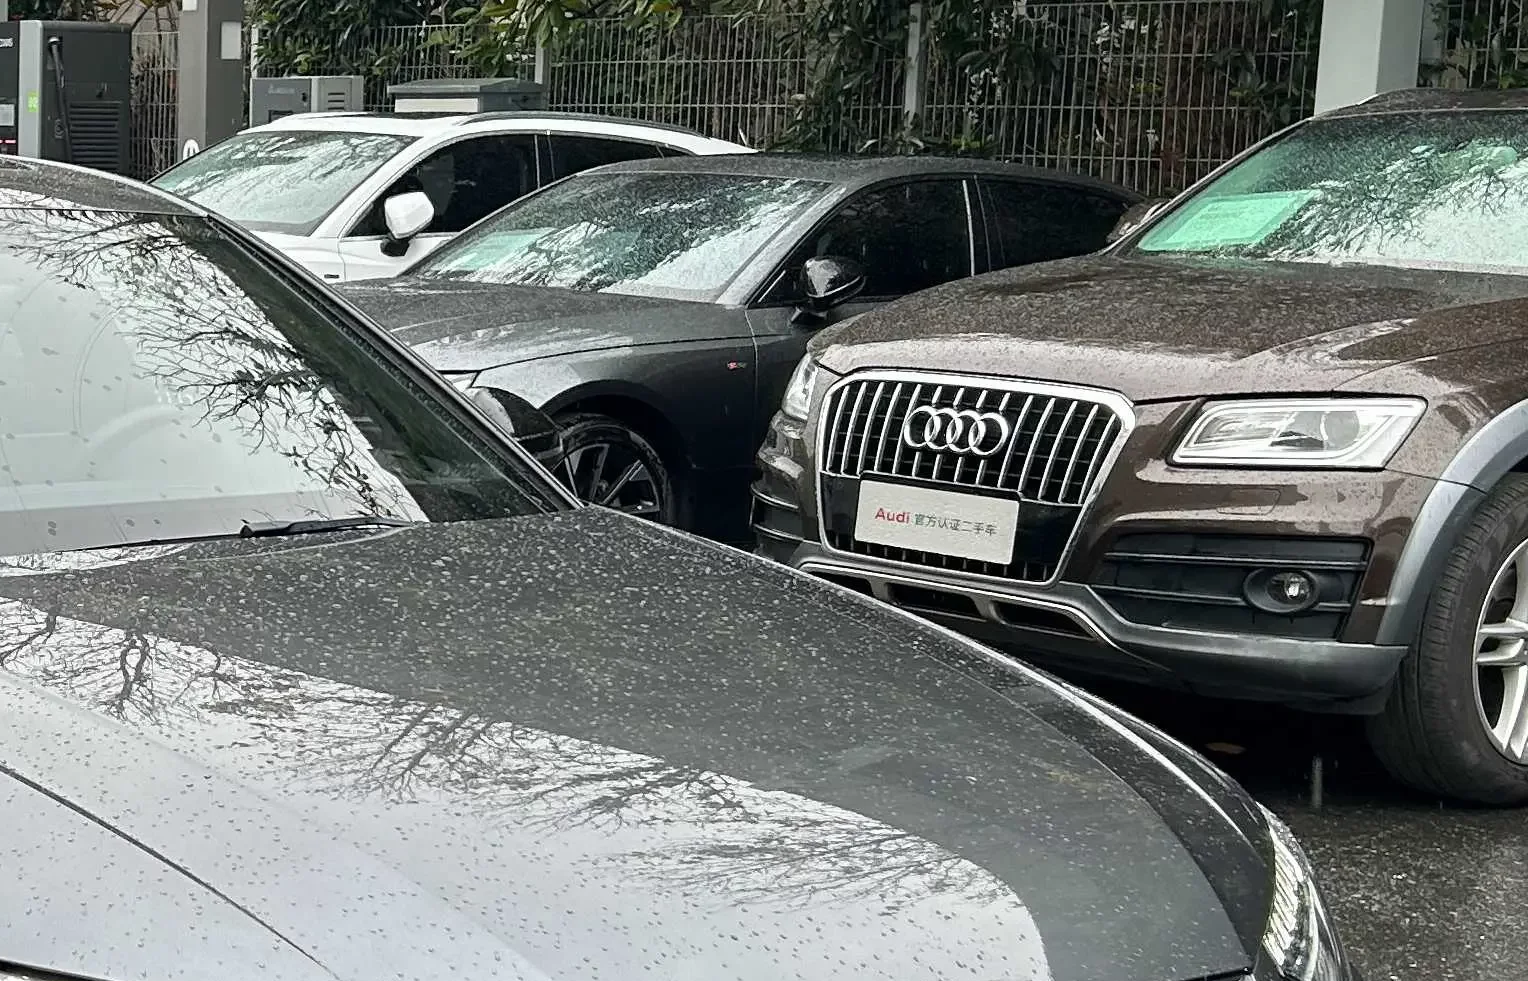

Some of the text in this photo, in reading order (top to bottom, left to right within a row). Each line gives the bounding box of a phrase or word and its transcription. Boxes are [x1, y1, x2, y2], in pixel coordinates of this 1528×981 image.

[875, 508, 997, 536] Audi 官方认证二手车
